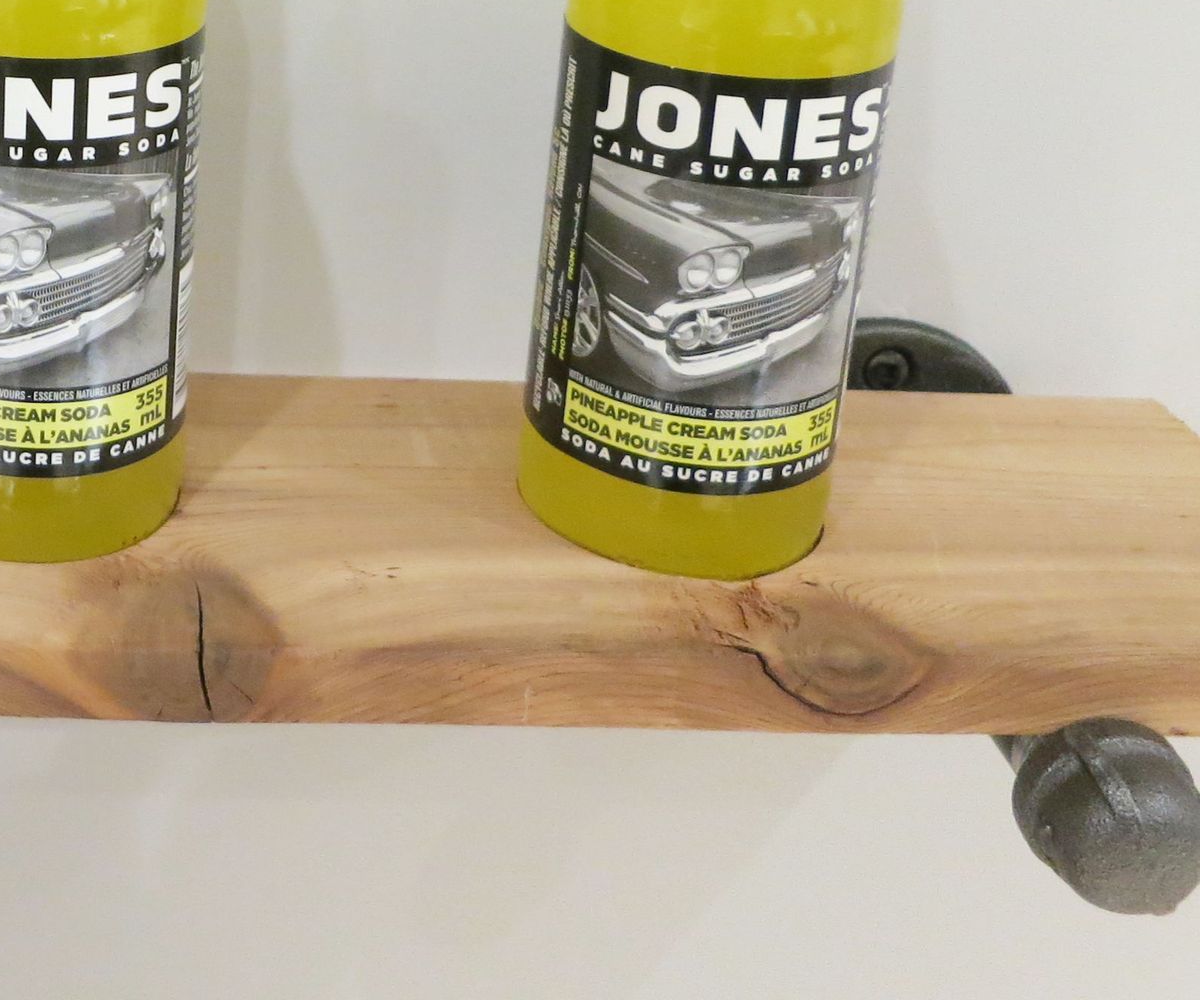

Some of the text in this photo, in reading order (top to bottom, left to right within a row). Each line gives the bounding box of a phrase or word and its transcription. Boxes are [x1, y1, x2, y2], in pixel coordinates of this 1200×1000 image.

[564, 54, 578, 110] PRESCRIT
[595, 70, 883, 162] JONES
[118, 128, 180, 156] SODA
[592, 134, 873, 182] CANE SUGAR SODA
[33, 390, 74, 401] ESSENCES
[76, 383, 121, 400] NATURELLES
[122, 380, 131, 391] ET
[136, 384, 164, 410] 355
[584, 376, 614, 396] NATURAL
[615, 391, 620, 399] &
[622, 392, 662, 411] ARTIFICIAL
[664, 402, 707, 417] FLAVOURS
[714, 408, 755, 419] ESSENCES
[756, 404, 798, 418] NATURELLES
[798, 402, 806, 412] ET
[60, 403, 112, 422] SODA
[140, 404, 162, 427] mL
[570, 388, 787, 440] PINEAPPLE CREAM SODA
[808, 406, 832, 432] 355
[21, 426, 36, 444] À
[40, 418, 131, 444] L'ANANAS
[74, 450, 101, 464] DE
[110, 426, 166, 458] CANNE
[568, 408, 802, 461] SODA MOUSSE À L'ANANAS
[810, 426, 828, 448] mL
[561, 427, 830, 483] SODA AU SUCRE DE CANNE
